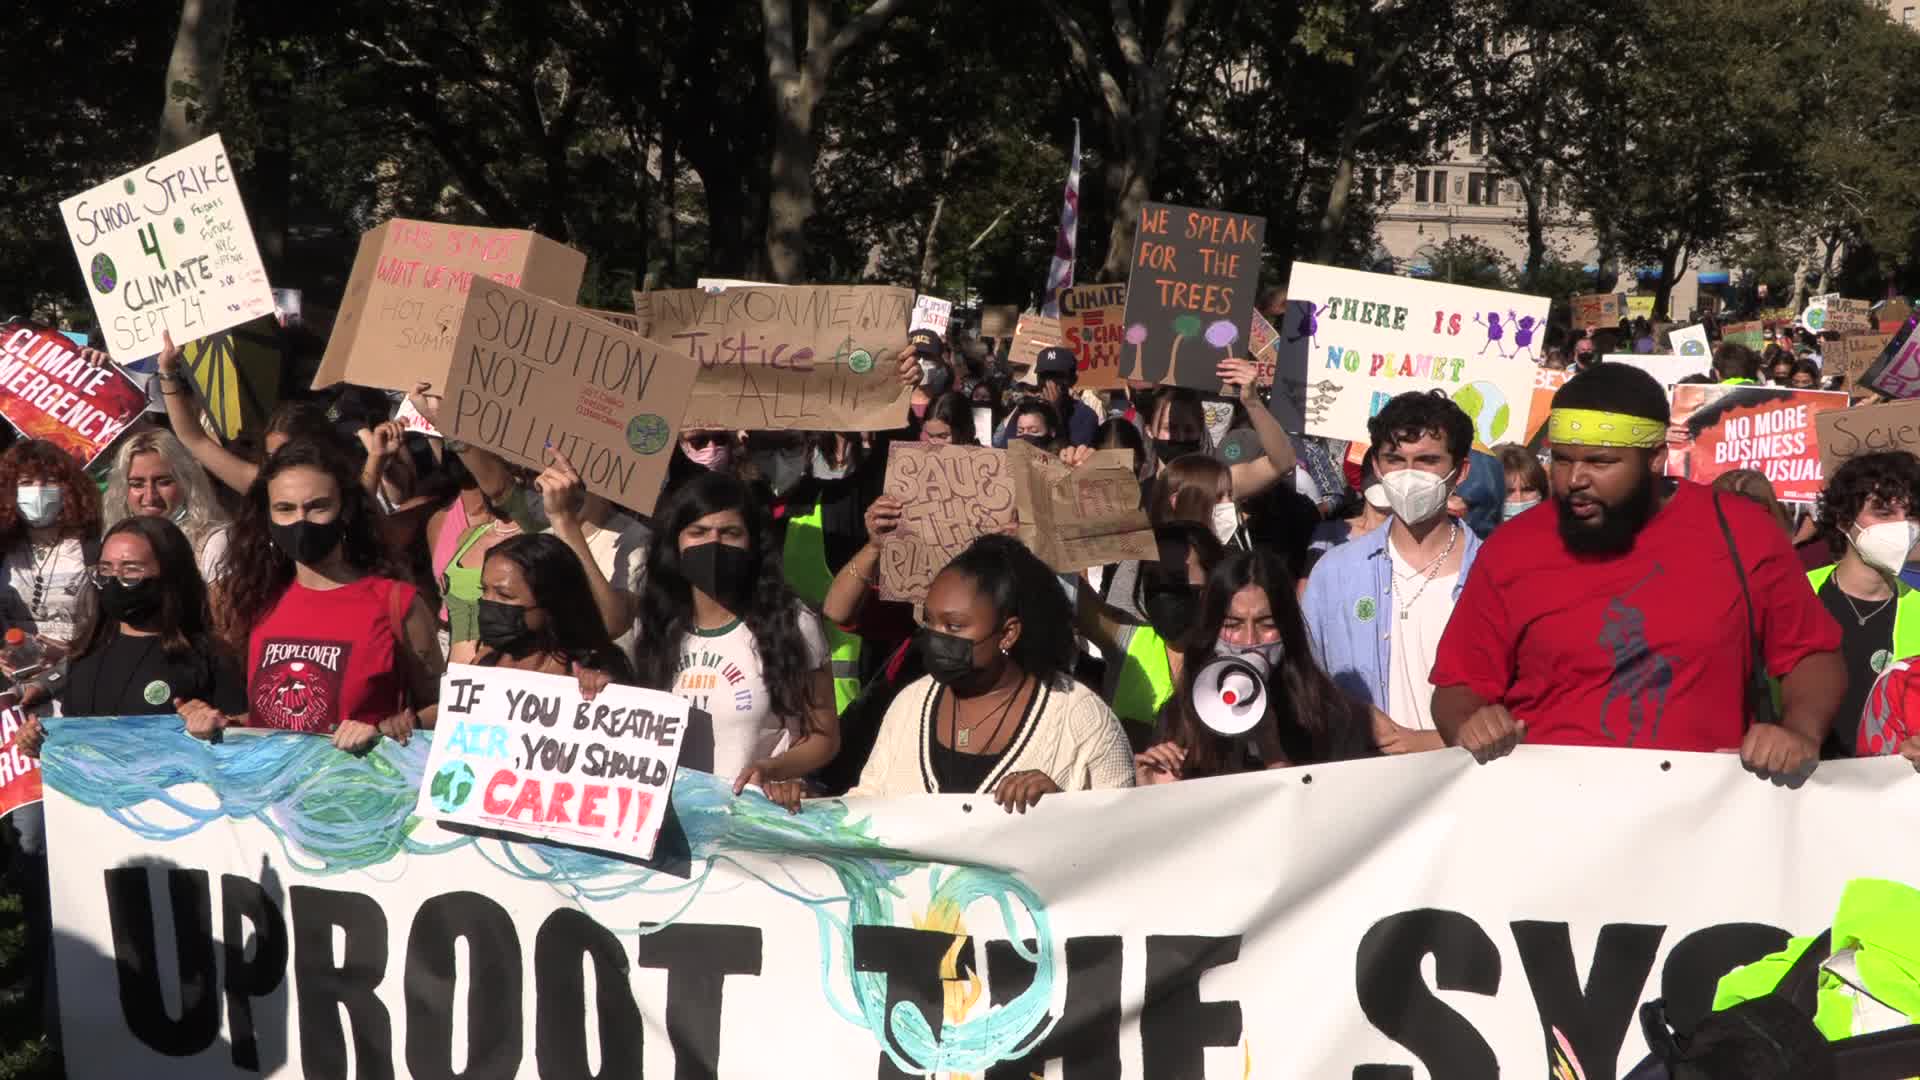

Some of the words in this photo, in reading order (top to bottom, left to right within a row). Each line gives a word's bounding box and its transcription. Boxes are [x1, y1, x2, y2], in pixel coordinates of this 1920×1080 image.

[76, 201, 141, 246] SCHOOL
[143, 154, 230, 215] STRIKE
[137, 222, 167, 270] 4
[1141, 207, 1169, 235] WE
[1185, 211, 1257, 243] SPEAK
[123, 255, 212, 311] CLIMATE
[1139, 242, 1177, 272] FOR
[1200, 249, 1241, 279] THE
[1058, 285, 1127, 317] CLIMATE
[1155, 279, 1235, 315] TREES
[1327, 296, 1409, 331] THERE
[1432, 311, 1462, 336] IS
[114, 305, 169, 350] SEPT
[477, 288, 659, 400] SOLUTION
[3, 328, 114, 396] CLIMATE
[466, 346, 545, 407] NOT
[1326, 345, 1361, 373] NO
[1368, 353, 1466, 384] PLANET
[0, 349, 123, 444] MERGENCY
[453, 390, 638, 495] POLLUTION
[1725, 418, 1751, 442] NO
[1754, 404, 1809, 437] MORE
[1829, 416, 1920, 457] Scie
[1715, 432, 1807, 464] BUSINESS
[1766, 458, 1824, 481] USUAL
[680, 673, 717, 690] EARTH
[447, 678, 485, 715] IF
[505, 689, 561, 728] YOU
[573, 702, 680, 747] BREATHE
[446, 721, 511, 760] AIR
[581, 743, 669, 788] SHOULD
[482, 769, 655, 843] CARE!!
[103, 866, 764, 1080] UPROOT
